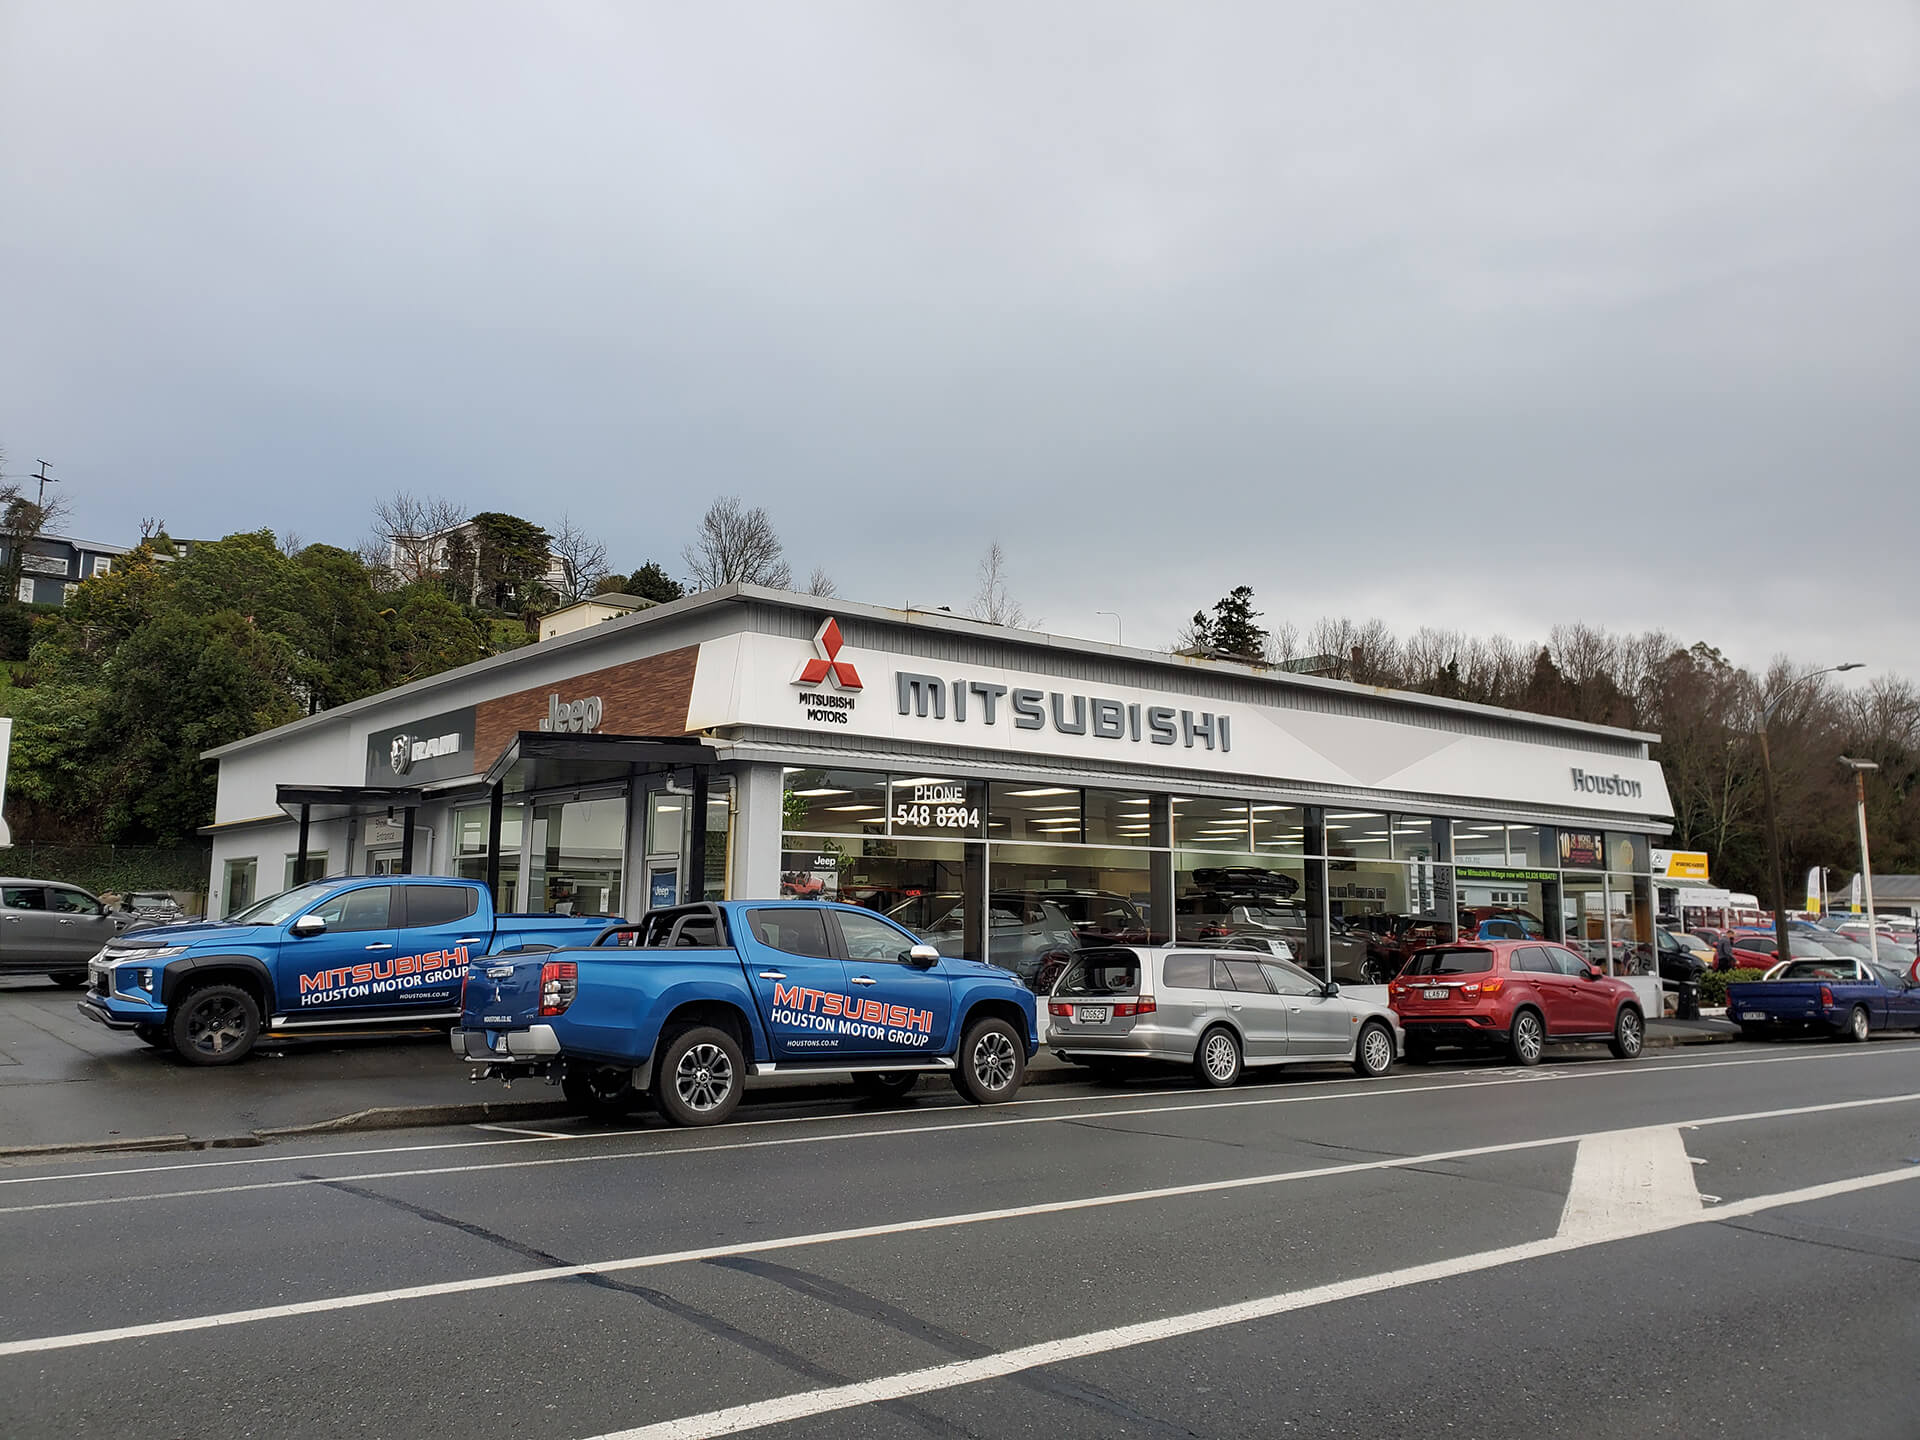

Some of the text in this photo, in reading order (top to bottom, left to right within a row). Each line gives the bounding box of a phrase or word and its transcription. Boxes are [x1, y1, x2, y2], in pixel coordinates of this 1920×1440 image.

[799, 692, 855, 709] MITSUBISHI
[895, 671, 1232, 753] MITSUBISHI
[539, 694, 603, 734] Jeep
[807, 709, 847, 724] MOTORS
[411, 733, 461, 762] RAM
[914, 785, 963, 801] PHONE
[1571, 767, 1642, 798] Houston
[897, 804, 980, 828] 548 8204
[814, 855, 836, 867] Jeep
[655, 885, 669, 898] Jeep
[300, 946, 469, 994] MITSUBISHI
[301, 966, 469, 1006] HOUSTON MOTOR GROUP
[399, 991, 450, 999] HOUSTONS.CO.NZ
[773, 982, 933, 1033] MITSUBISHI
[771, 1008, 929, 1047] HOUSTON MOTOR GROUP
[787, 1039, 839, 1047] HOUSTONS.CO.NZ
